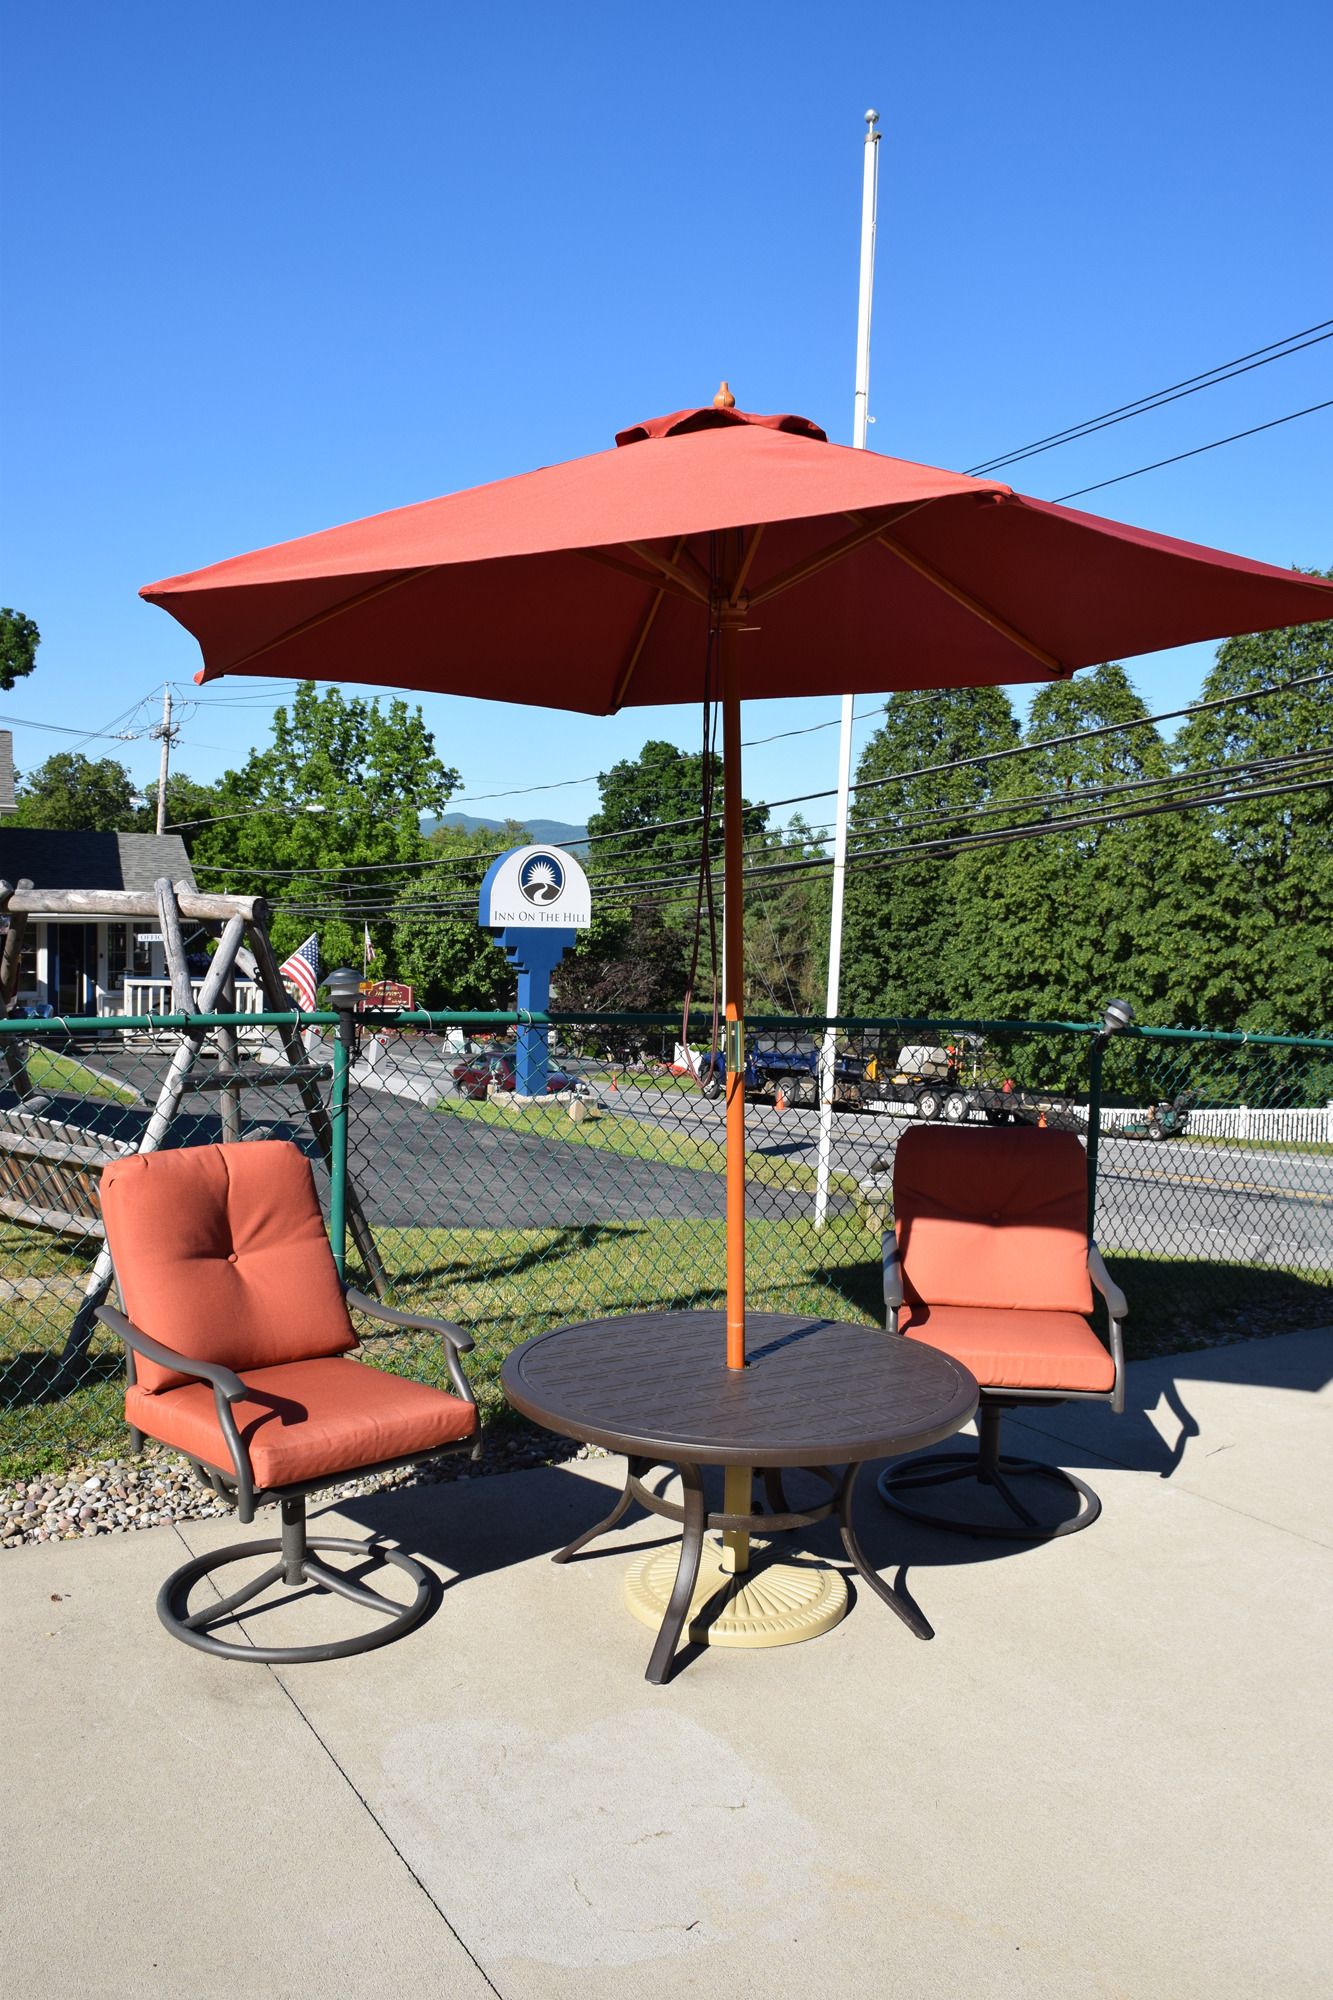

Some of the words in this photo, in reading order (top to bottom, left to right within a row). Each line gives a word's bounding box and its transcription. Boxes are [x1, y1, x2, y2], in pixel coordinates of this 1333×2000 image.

[494, 911, 514, 921] INN
[518, 911, 535, 921] ON
[539, 912, 560, 922] THE
[563, 912, 586, 922] HILL
